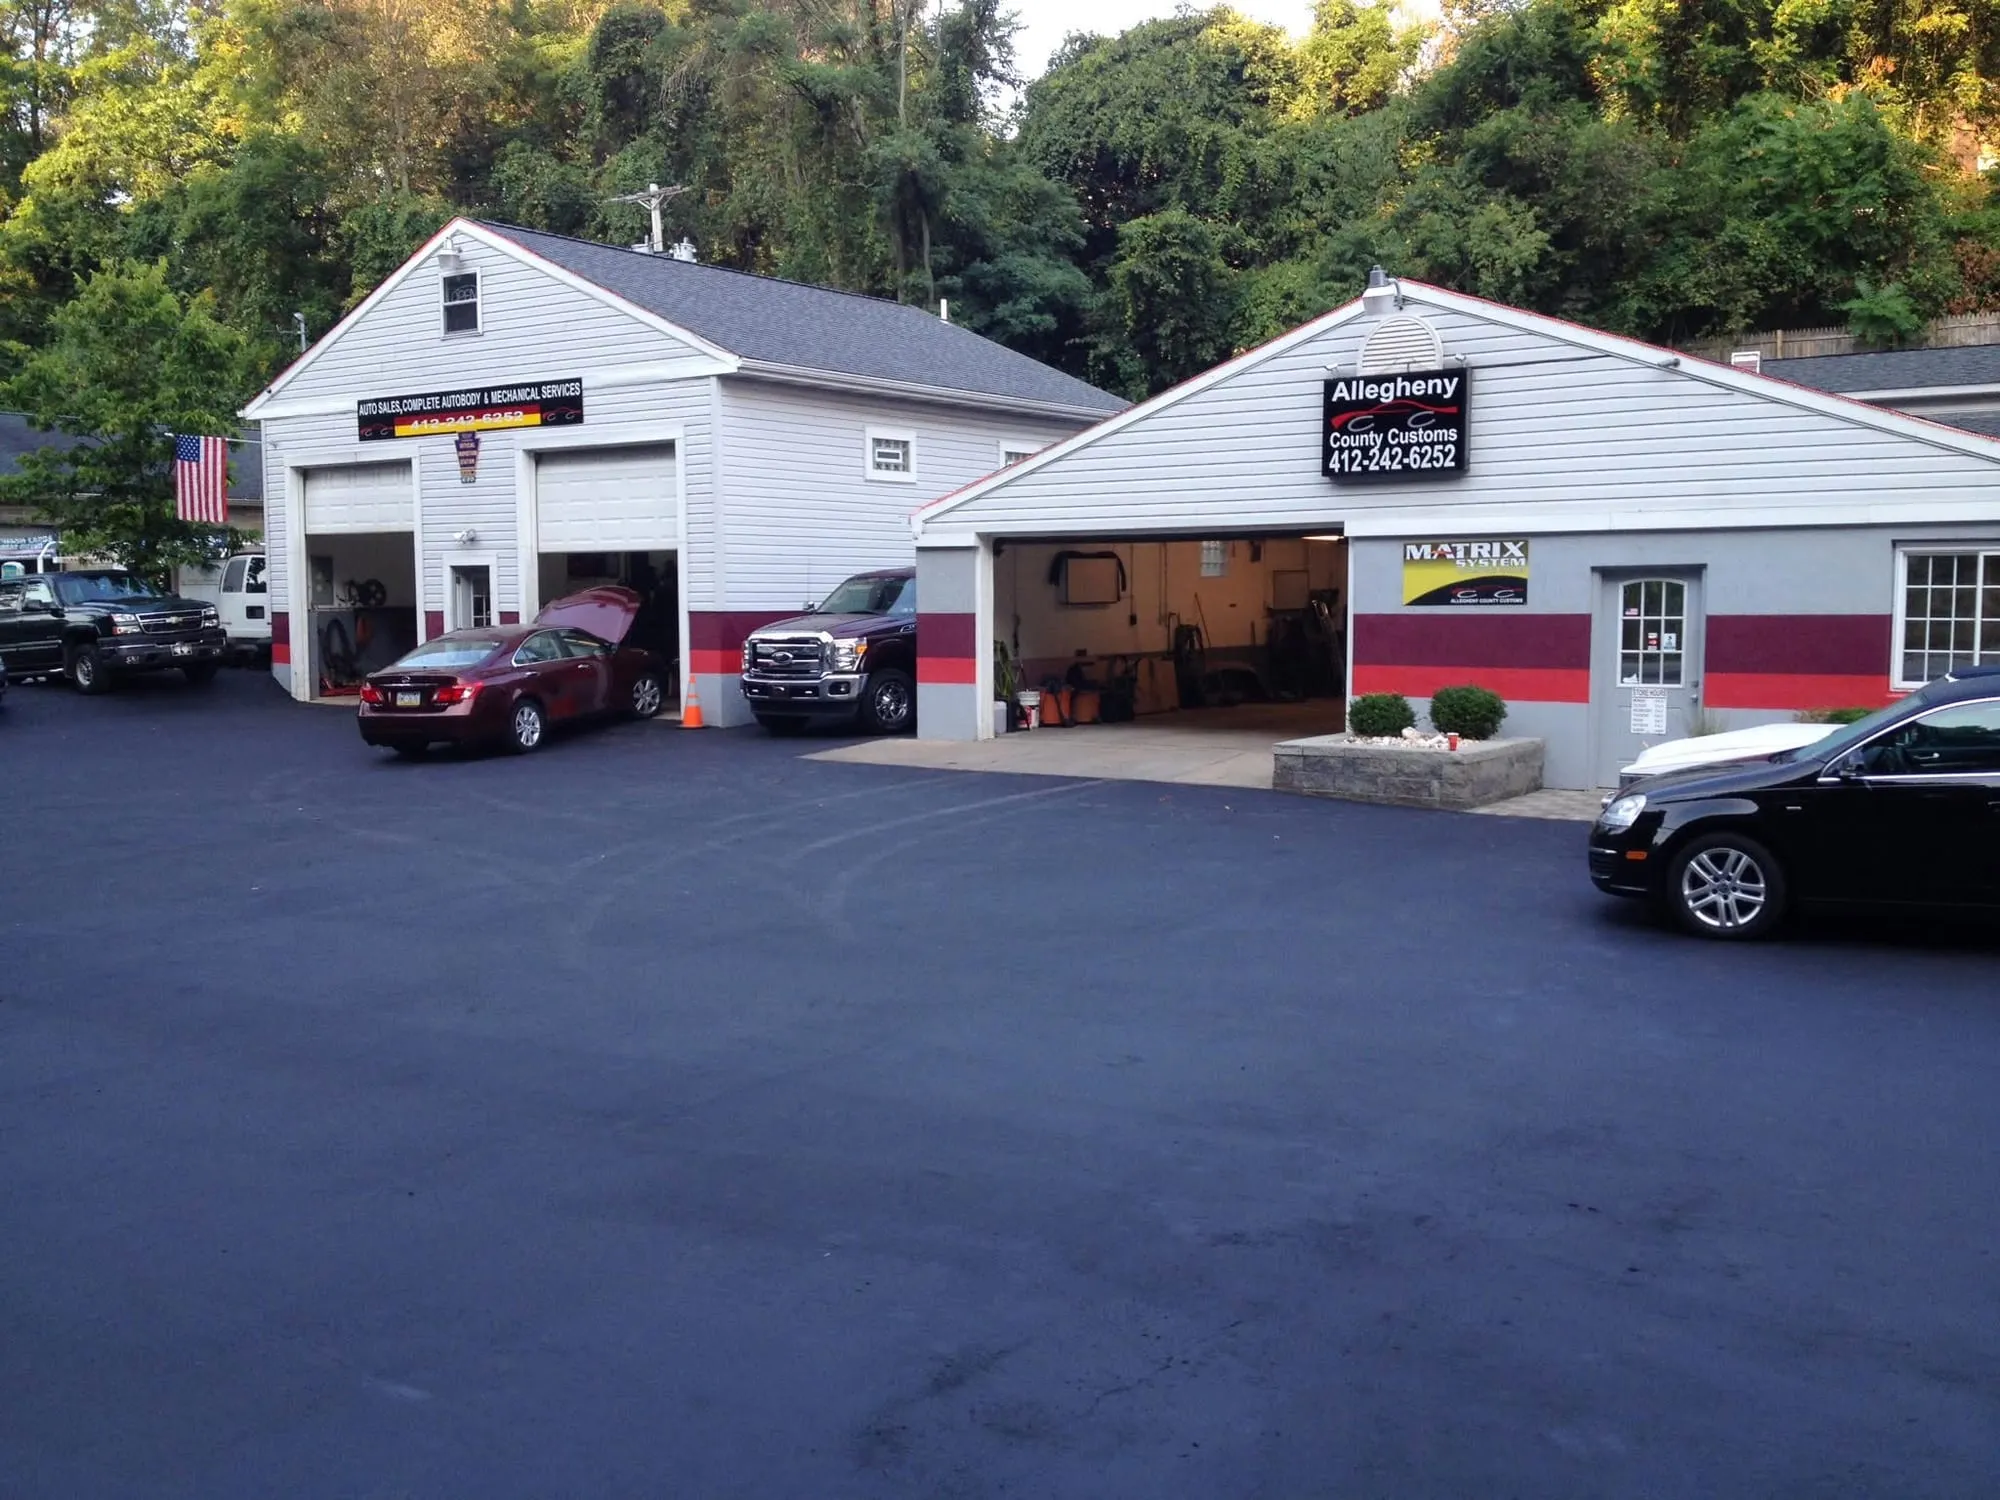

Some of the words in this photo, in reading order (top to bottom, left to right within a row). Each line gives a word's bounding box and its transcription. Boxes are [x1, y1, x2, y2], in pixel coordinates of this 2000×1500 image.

[359, 402, 378, 416] AUTO
[378, 400, 403, 415] SALES,
[402, 396, 440, 412] COMPLETE
[441, 391, 481, 408] AUTOBODY
[484, 392, 489, 404] &
[491, 387, 541, 404] MECHANICAL
[541, 382, 580, 399] SERVICES
[1331, 377, 1459, 403] Allegheny
[411, 410, 524, 430] 412-242-6252
[1329, 430, 1383, 449] County
[1388, 427, 1458, 445] Customs
[1328, 443, 1456, 473] 412-242-6252
[1406, 541, 1525, 560] MATRIX
[1455, 558, 1525, 568] SYSTEM
